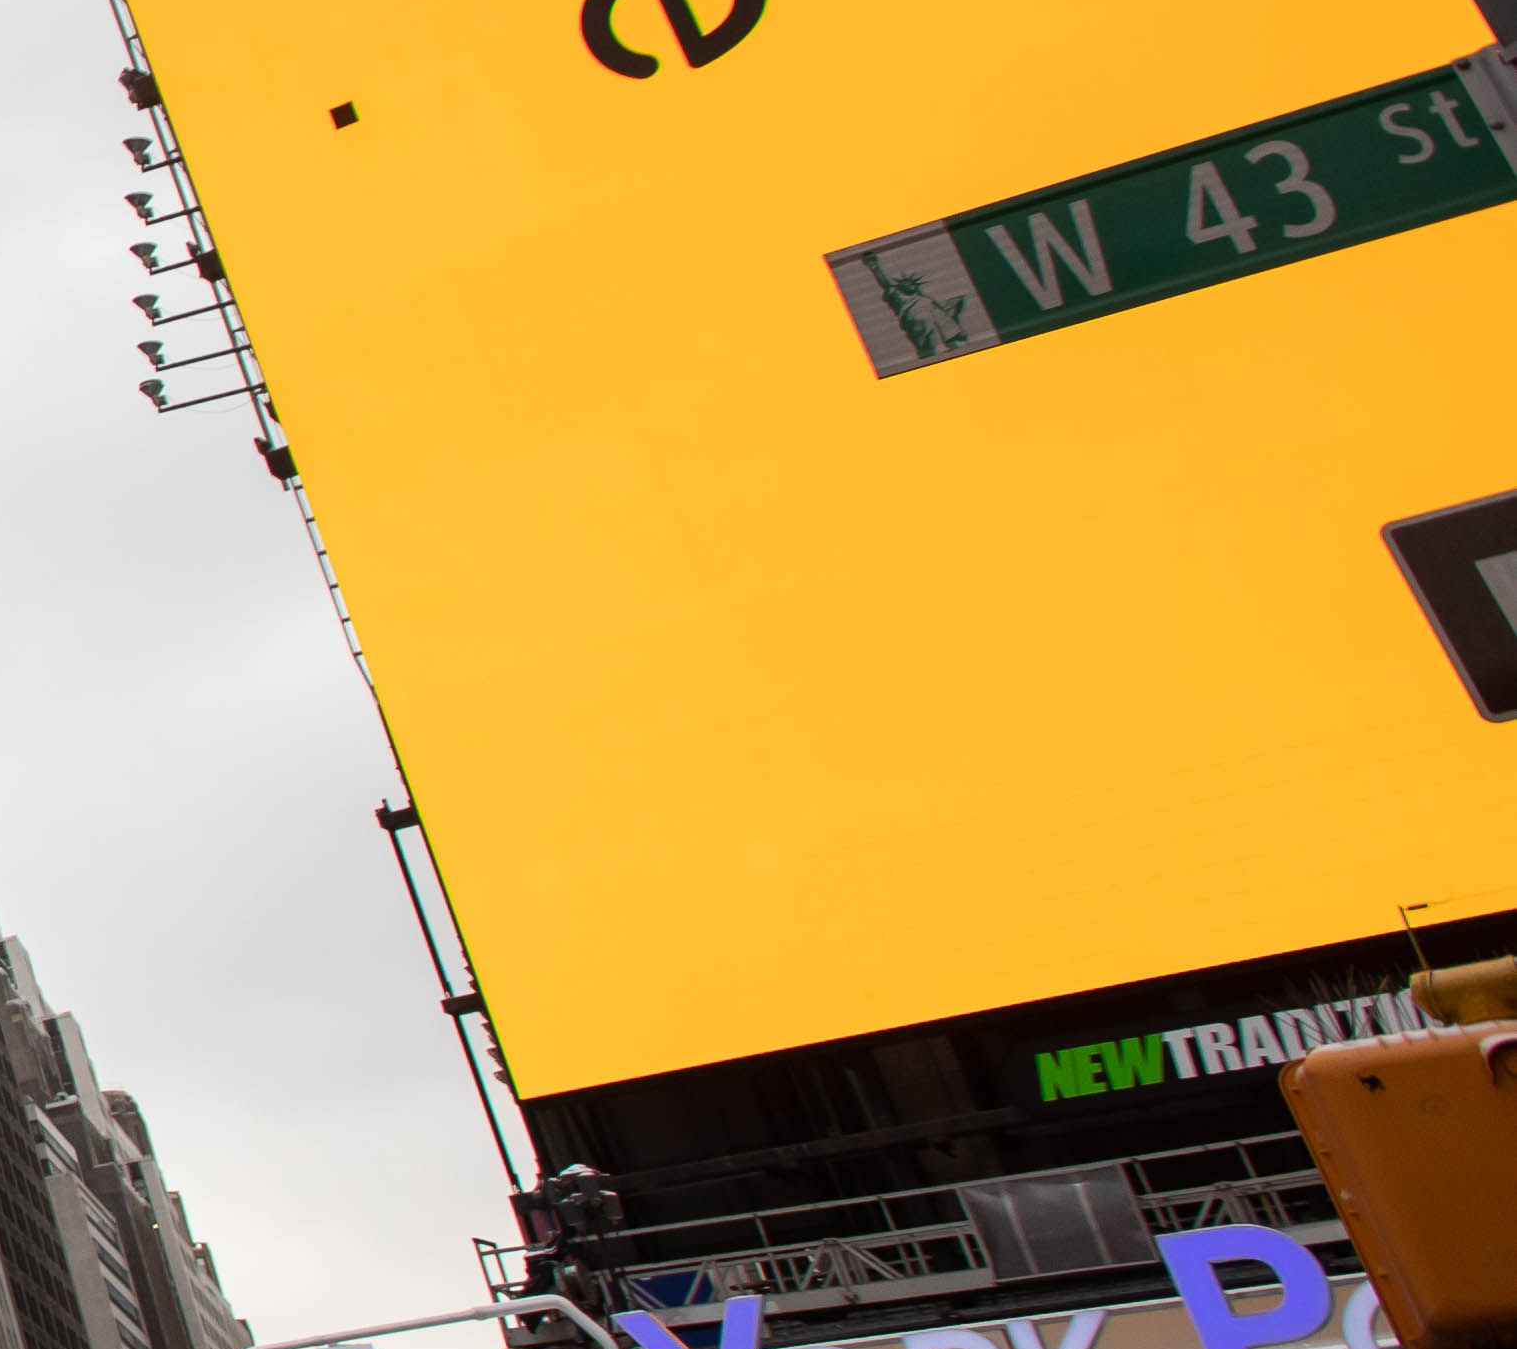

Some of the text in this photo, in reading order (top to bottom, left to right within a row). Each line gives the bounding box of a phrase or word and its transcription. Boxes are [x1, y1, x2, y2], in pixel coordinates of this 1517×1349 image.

[984, 89, 1478, 311] W 43 St
